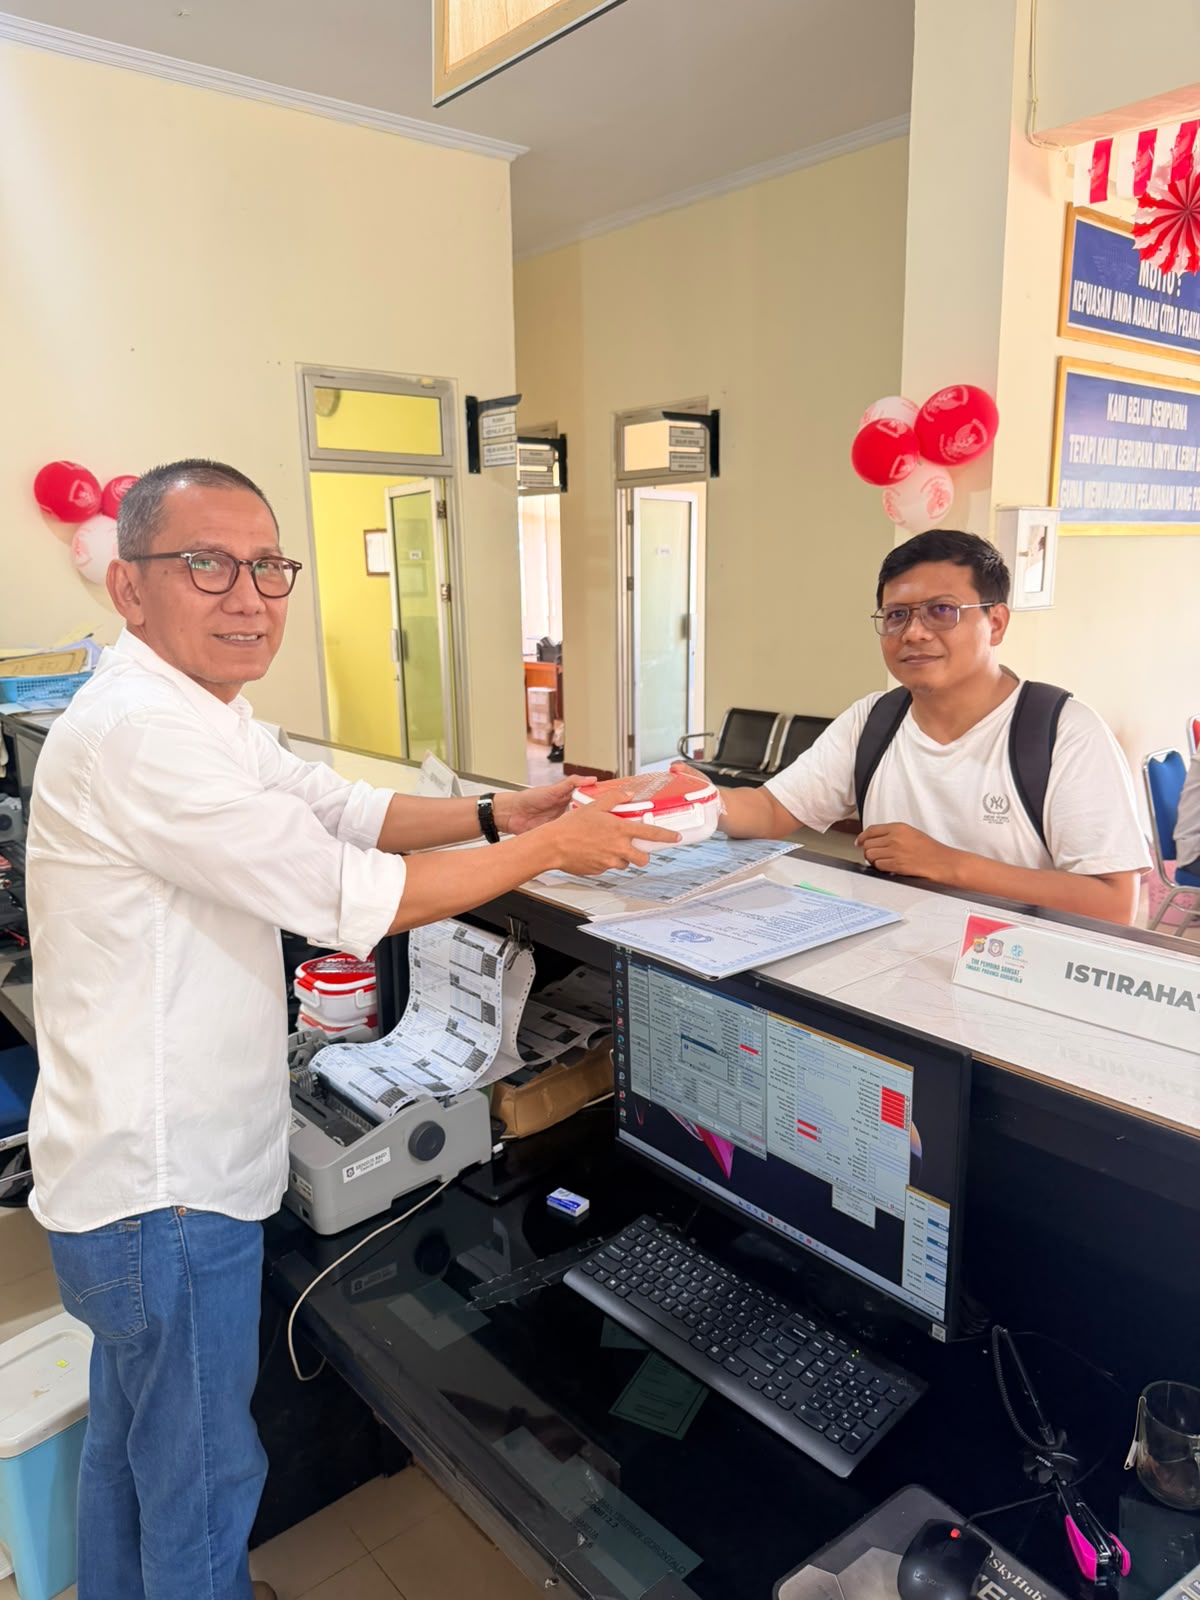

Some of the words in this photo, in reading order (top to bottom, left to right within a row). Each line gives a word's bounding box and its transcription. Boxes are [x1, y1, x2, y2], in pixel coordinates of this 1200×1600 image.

[1072, 279, 1112, 319] KEPUASAN
[1111, 291, 1132, 324] ANDA
[1132, 296, 1160, 331] ADALAH
[1160, 303, 1178, 335] CITRA
[1107, 393, 1127, 422] KAMI
[1126, 396, 1153, 426] BELUM
[1152, 400, 1188, 431] SEMPURNA
[1069, 433, 1097, 465] TETAPI
[1096, 437, 1118, 466] KAMI
[1153, 442, 1178, 471] UNTUK
[1177, 445, 1197, 472] LEBIH
[1065, 961, 1200, 1012] ISTIRAHA
